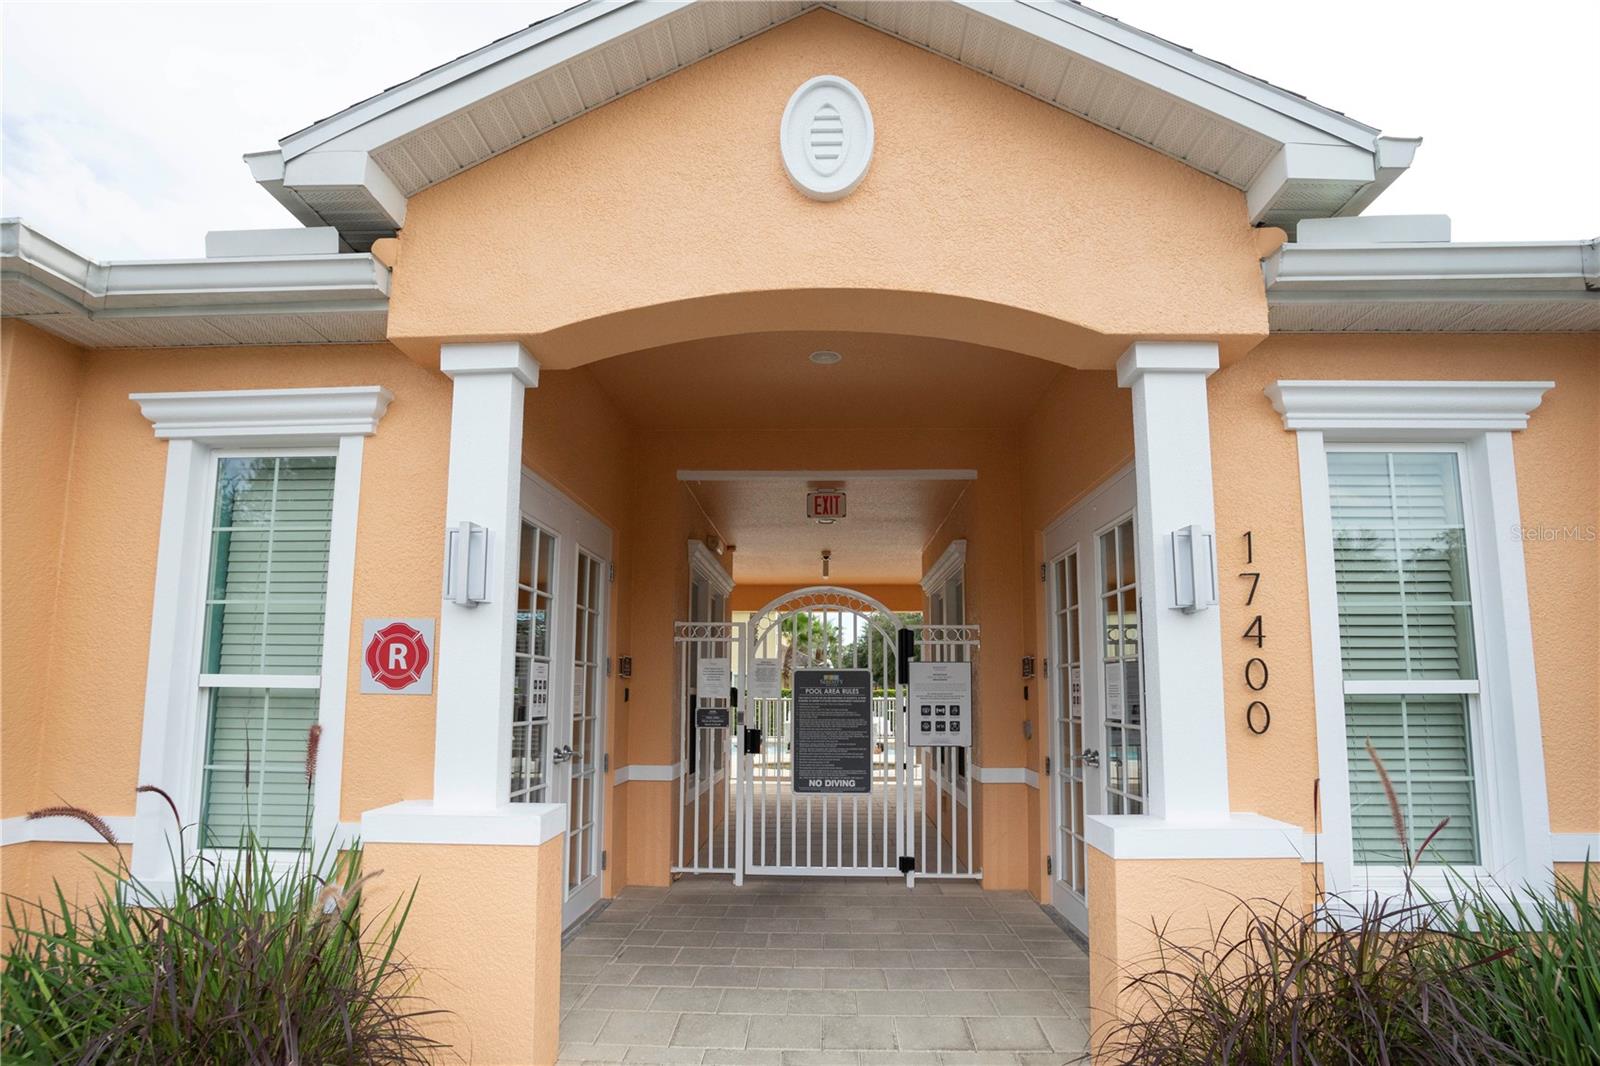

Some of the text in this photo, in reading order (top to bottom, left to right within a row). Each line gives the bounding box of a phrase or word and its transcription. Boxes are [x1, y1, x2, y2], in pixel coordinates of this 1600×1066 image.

[814, 495, 841, 515] EXIT
[1238, 530, 1271, 735] 17400
[388, 642, 408, 670] R
[808, 779, 856, 787] NO DIVING
